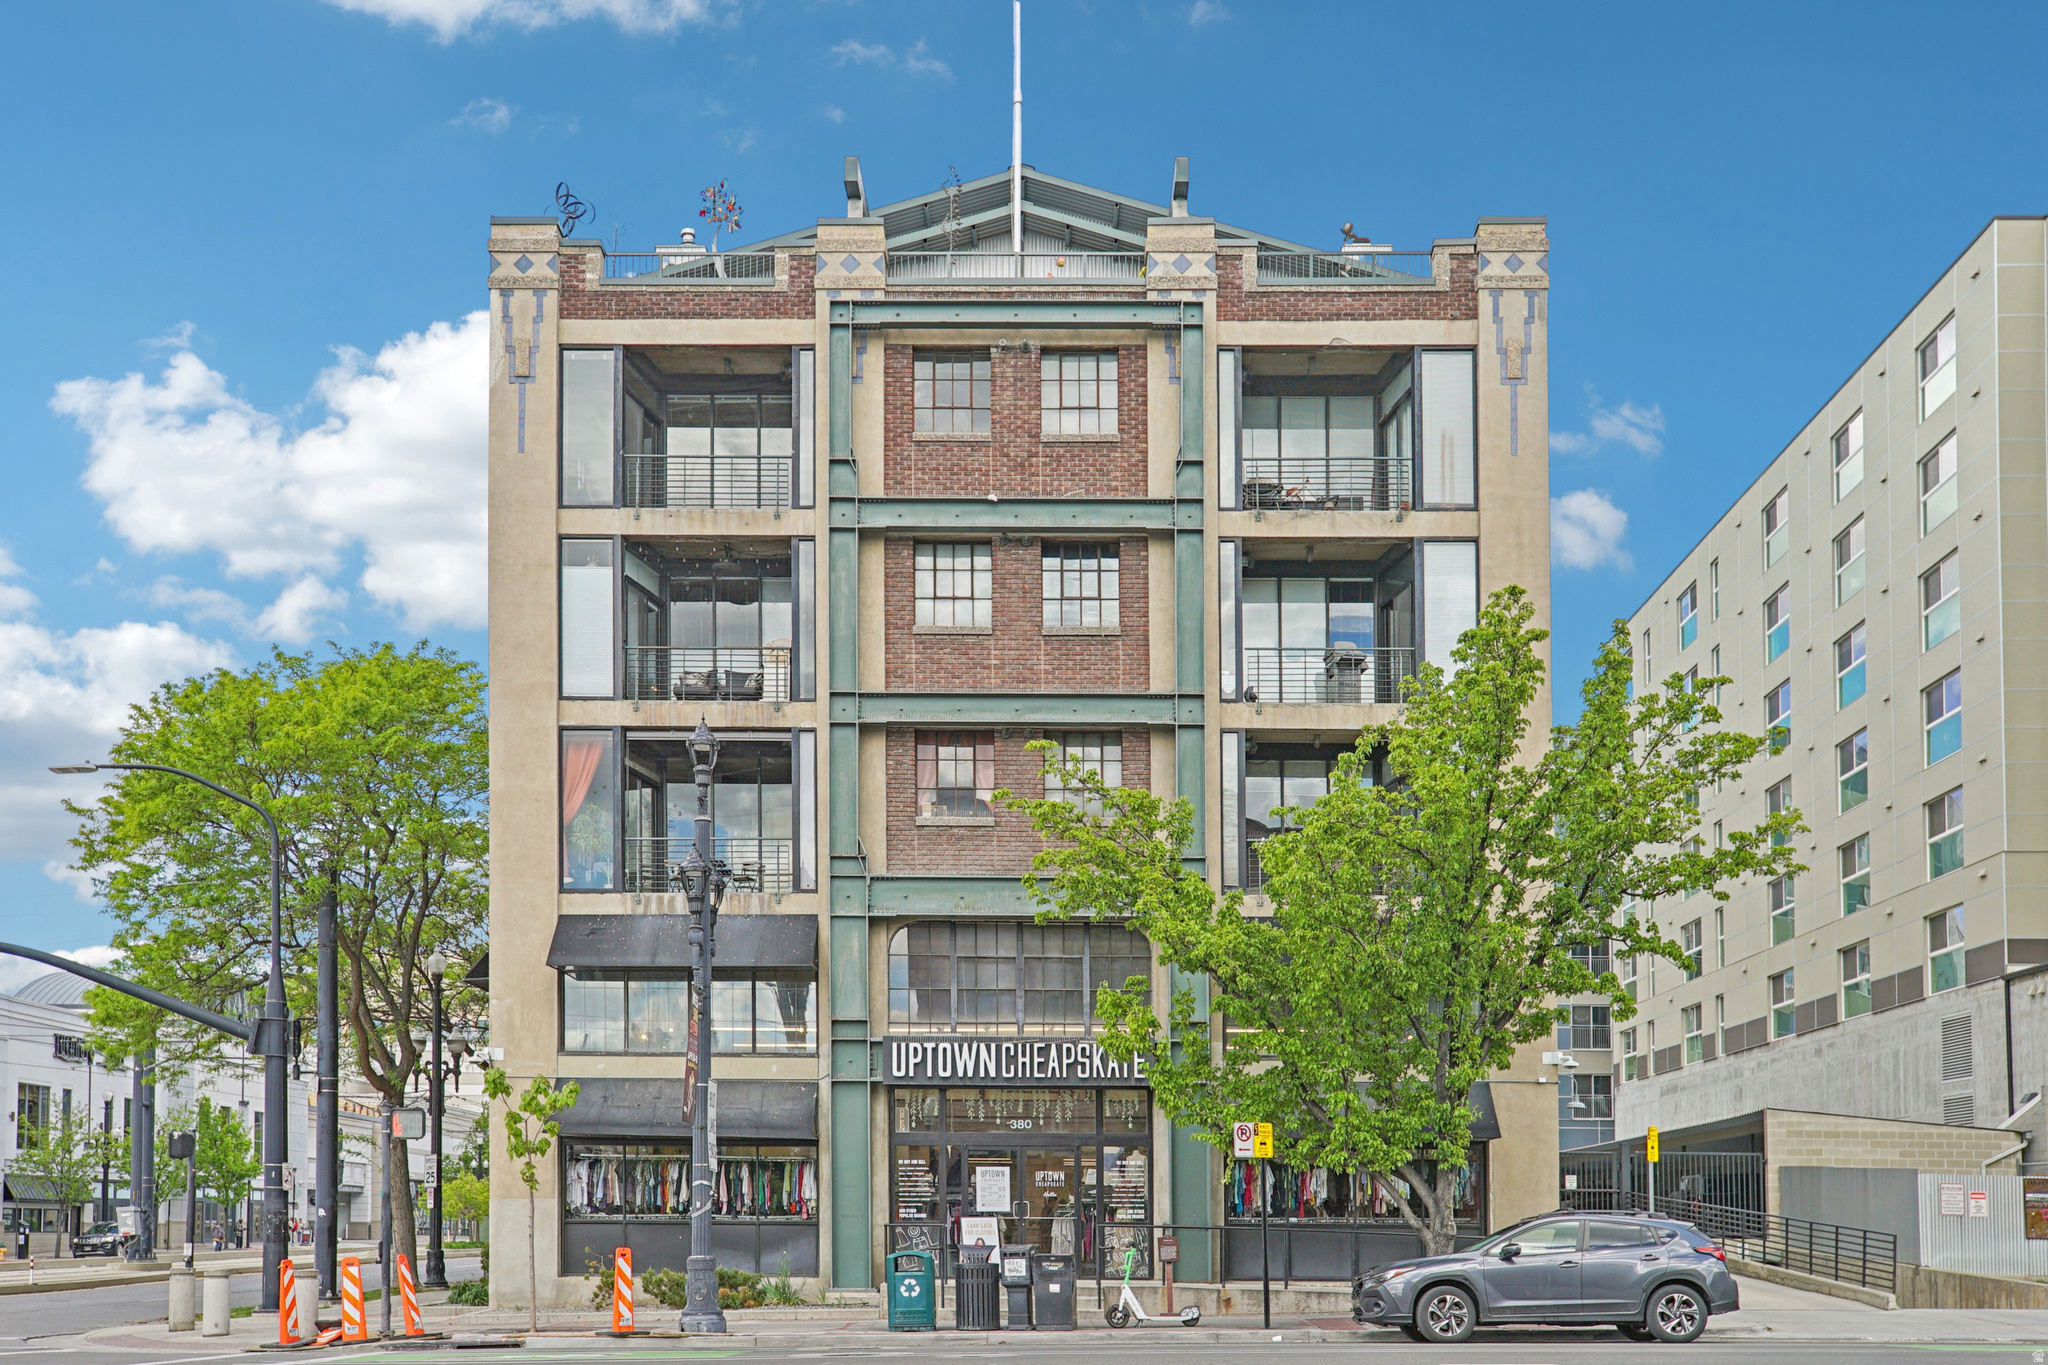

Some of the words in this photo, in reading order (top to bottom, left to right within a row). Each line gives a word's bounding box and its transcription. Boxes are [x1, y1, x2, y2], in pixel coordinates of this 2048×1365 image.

[892, 1042, 997, 1078] UPTOWN
[1010, 1119, 1032, 1129] 380
[425, 1171, 435, 1183] 25
[981, 1170, 1005, 1178] UPTOWN
[1035, 1171, 1065, 1181] UPTOWN
